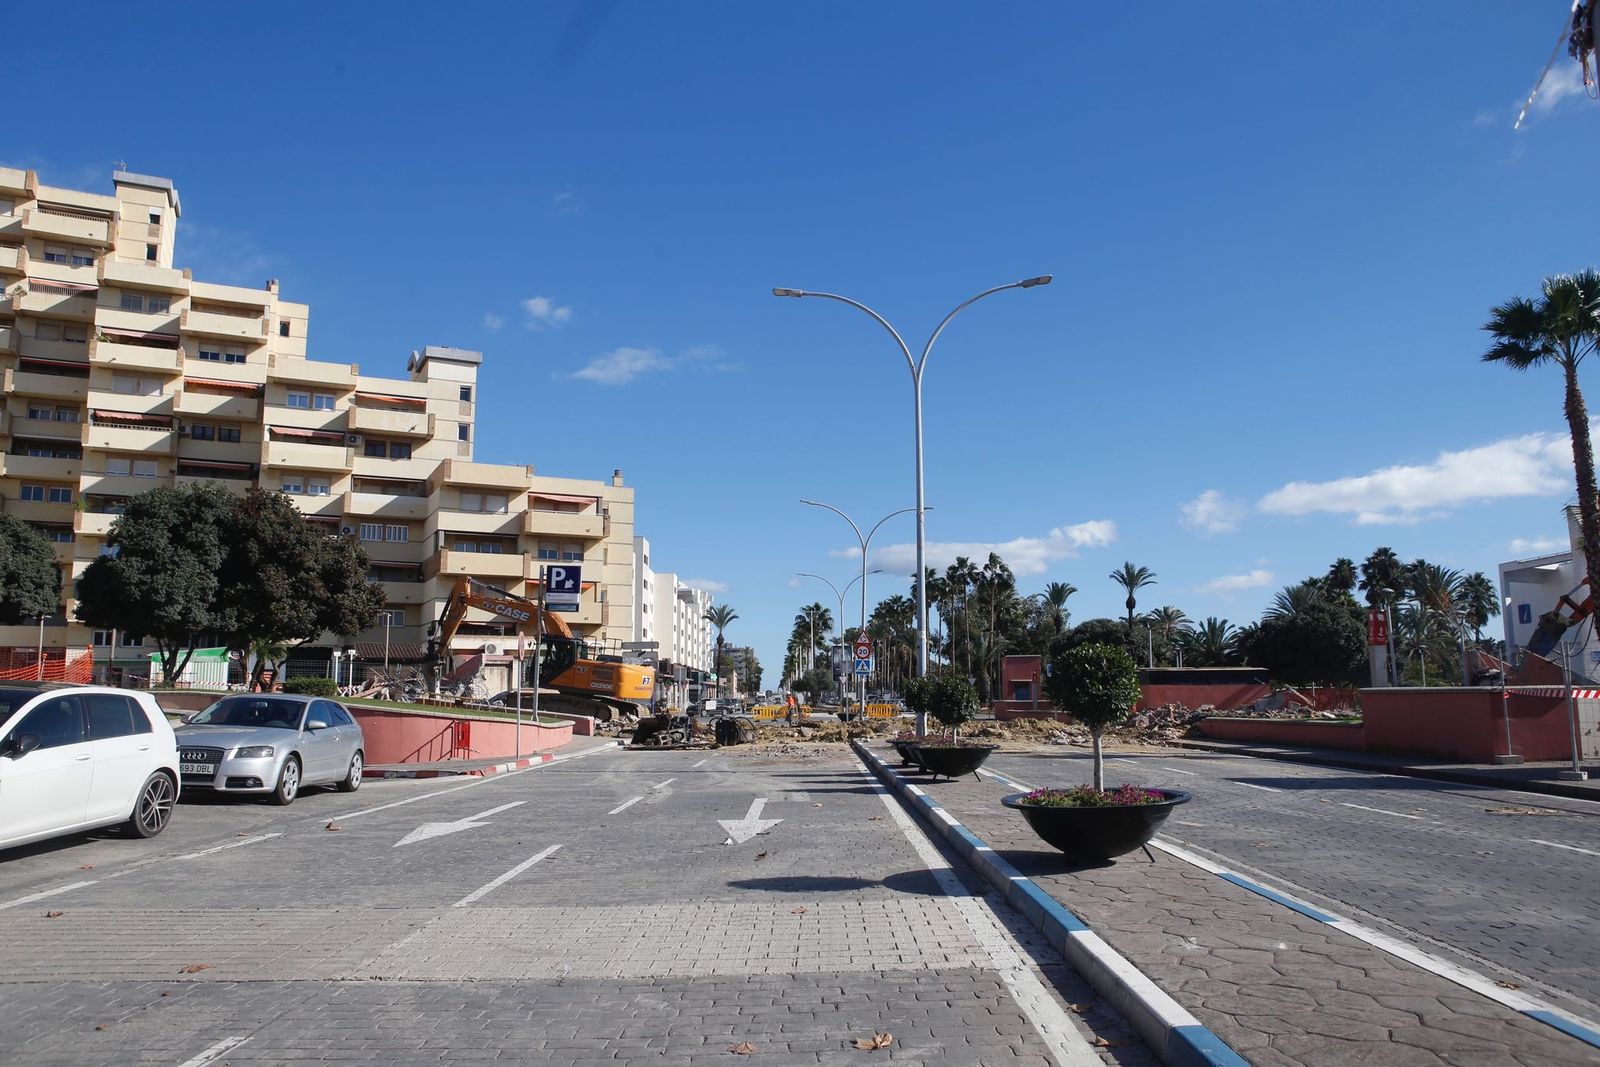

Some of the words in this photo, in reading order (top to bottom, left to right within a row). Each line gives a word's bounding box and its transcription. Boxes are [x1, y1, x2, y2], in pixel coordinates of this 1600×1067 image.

[551, 567, 566, 589] P
[495, 604, 529, 621] CASE
[196, 765, 212, 773] DBL
